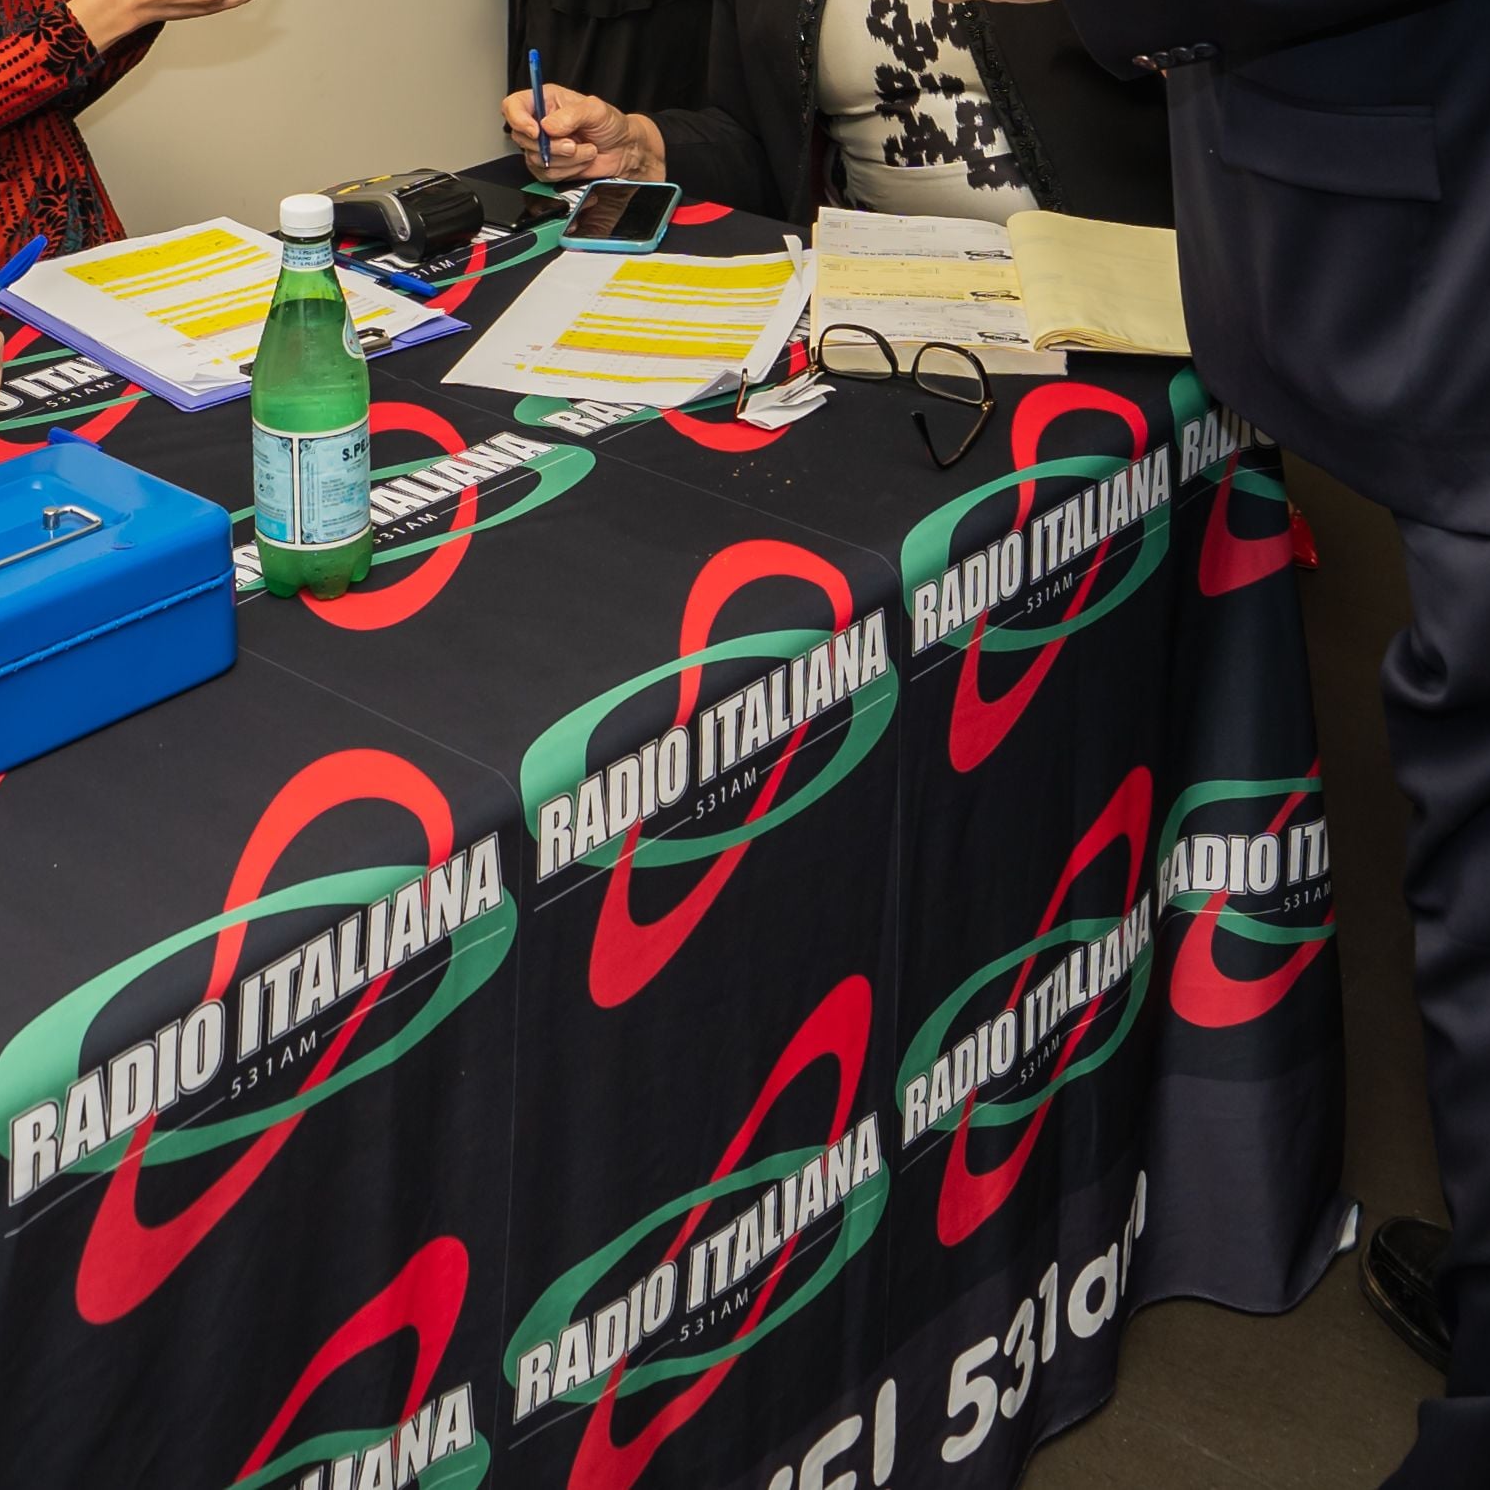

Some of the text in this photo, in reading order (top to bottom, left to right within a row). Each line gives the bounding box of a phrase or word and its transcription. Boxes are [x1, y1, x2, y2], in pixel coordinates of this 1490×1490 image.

[409, 259, 456, 280] 31AM
[46, 379, 114, 408] 531AM
[912, 443, 1171, 657] RADIO ITALIANA
[1027, 572, 1073, 614] 531AM
[537, 608, 889, 884] RADIO ITALIANA
[696, 767, 758, 820] 531AM
[9, 831, 505, 1207] RADIO ITALIANA
[902, 889, 1151, 1150] RADIO ITALIANA
[230, 1029, 318, 1100] 531AM
[1020, 1034, 1060, 1086] 531AM
[513, 1111, 882, 1425] RADIO ITALIANA
[680, 1288, 749, 1343] 531AM
